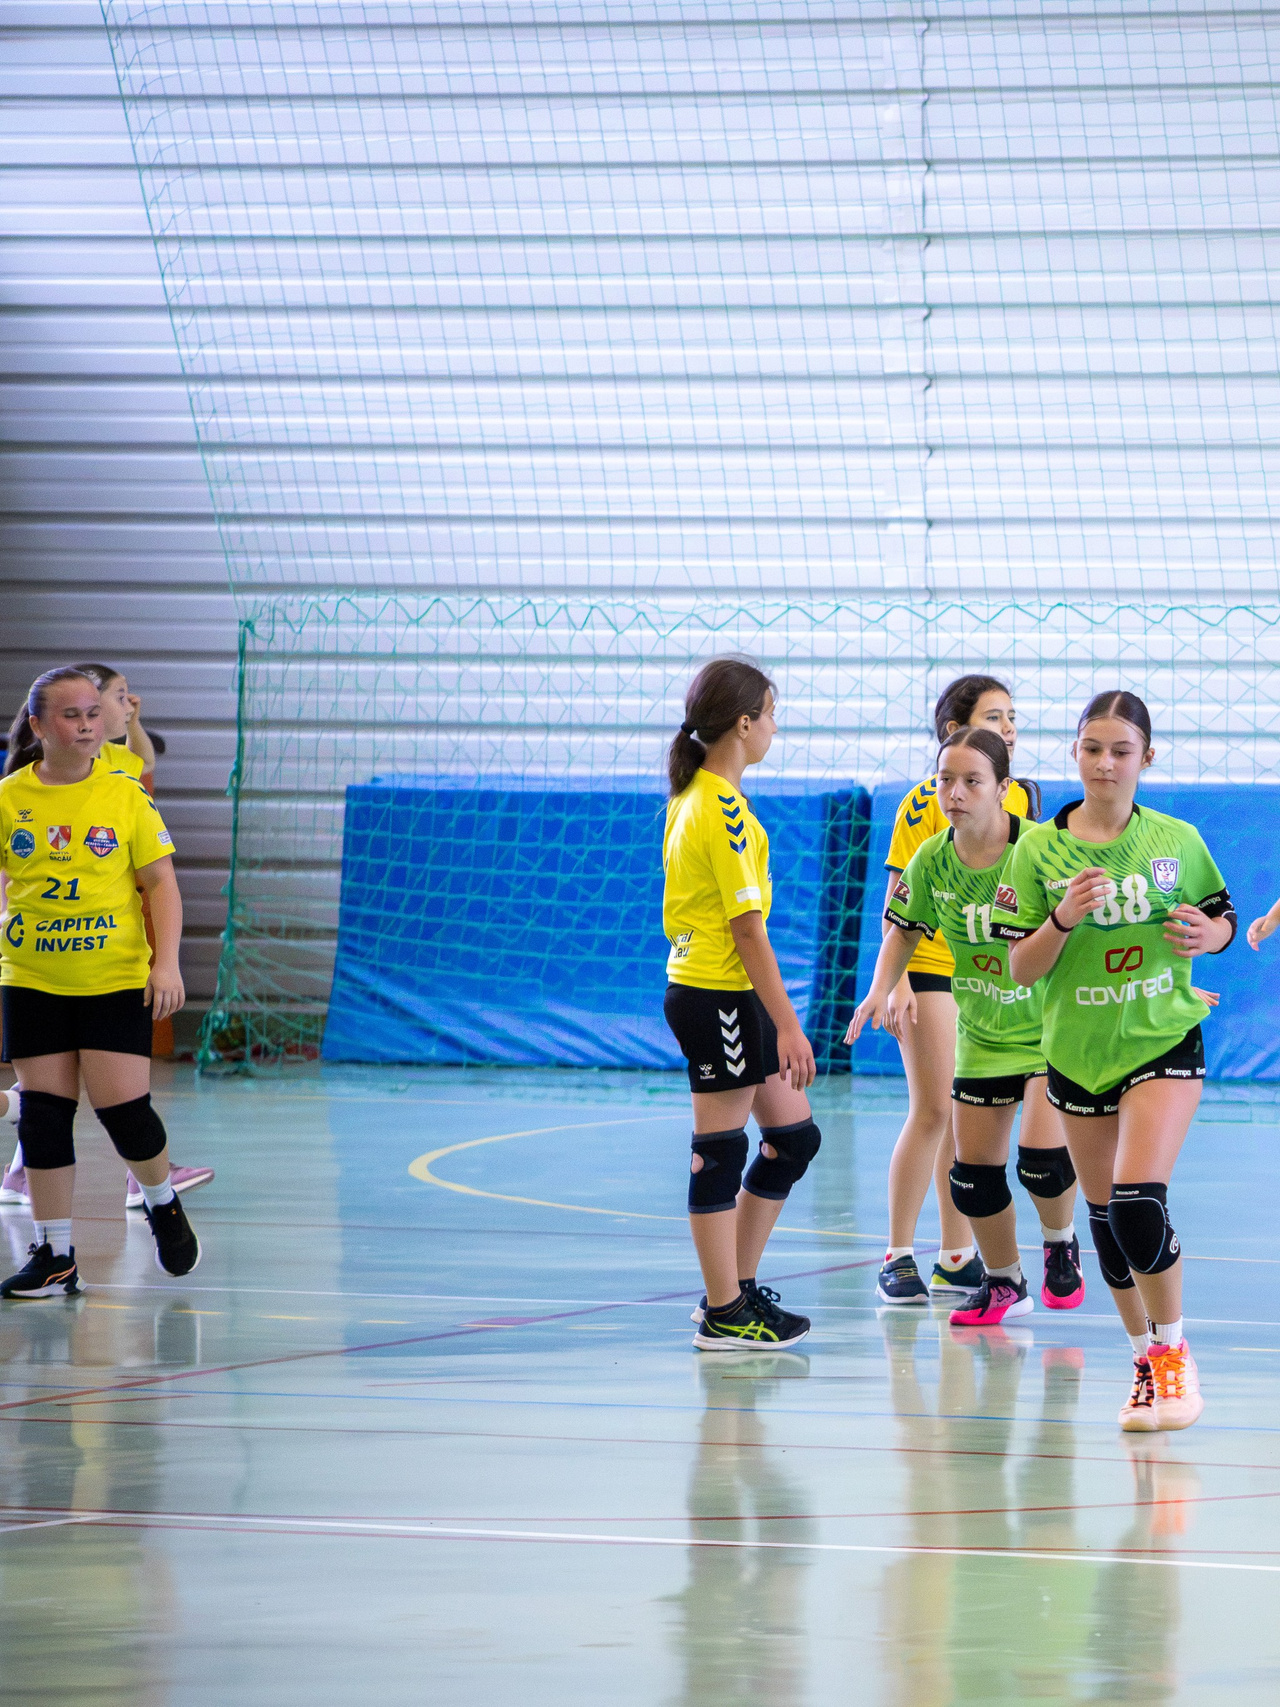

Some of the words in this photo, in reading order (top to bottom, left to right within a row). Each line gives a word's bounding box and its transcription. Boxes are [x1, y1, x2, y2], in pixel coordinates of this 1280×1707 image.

[41, 877, 80, 900] 21
[36, 915, 117, 932] CAPITAL
[887, 910, 909, 928] Kempa
[961, 903, 994, 943] 11
[999, 926, 1026, 939] Kempa
[36, 935, 107, 951] INVEST
[1075, 966, 1174, 1006] covired
[1130, 1070, 1156, 1086] Kempa
[1165, 1067, 1192, 1078] Kempa
[960, 1090, 985, 1104] Kempa
[992, 1096, 1015, 1105] Kempa
[1065, 1101, 1095, 1115] Kempa
